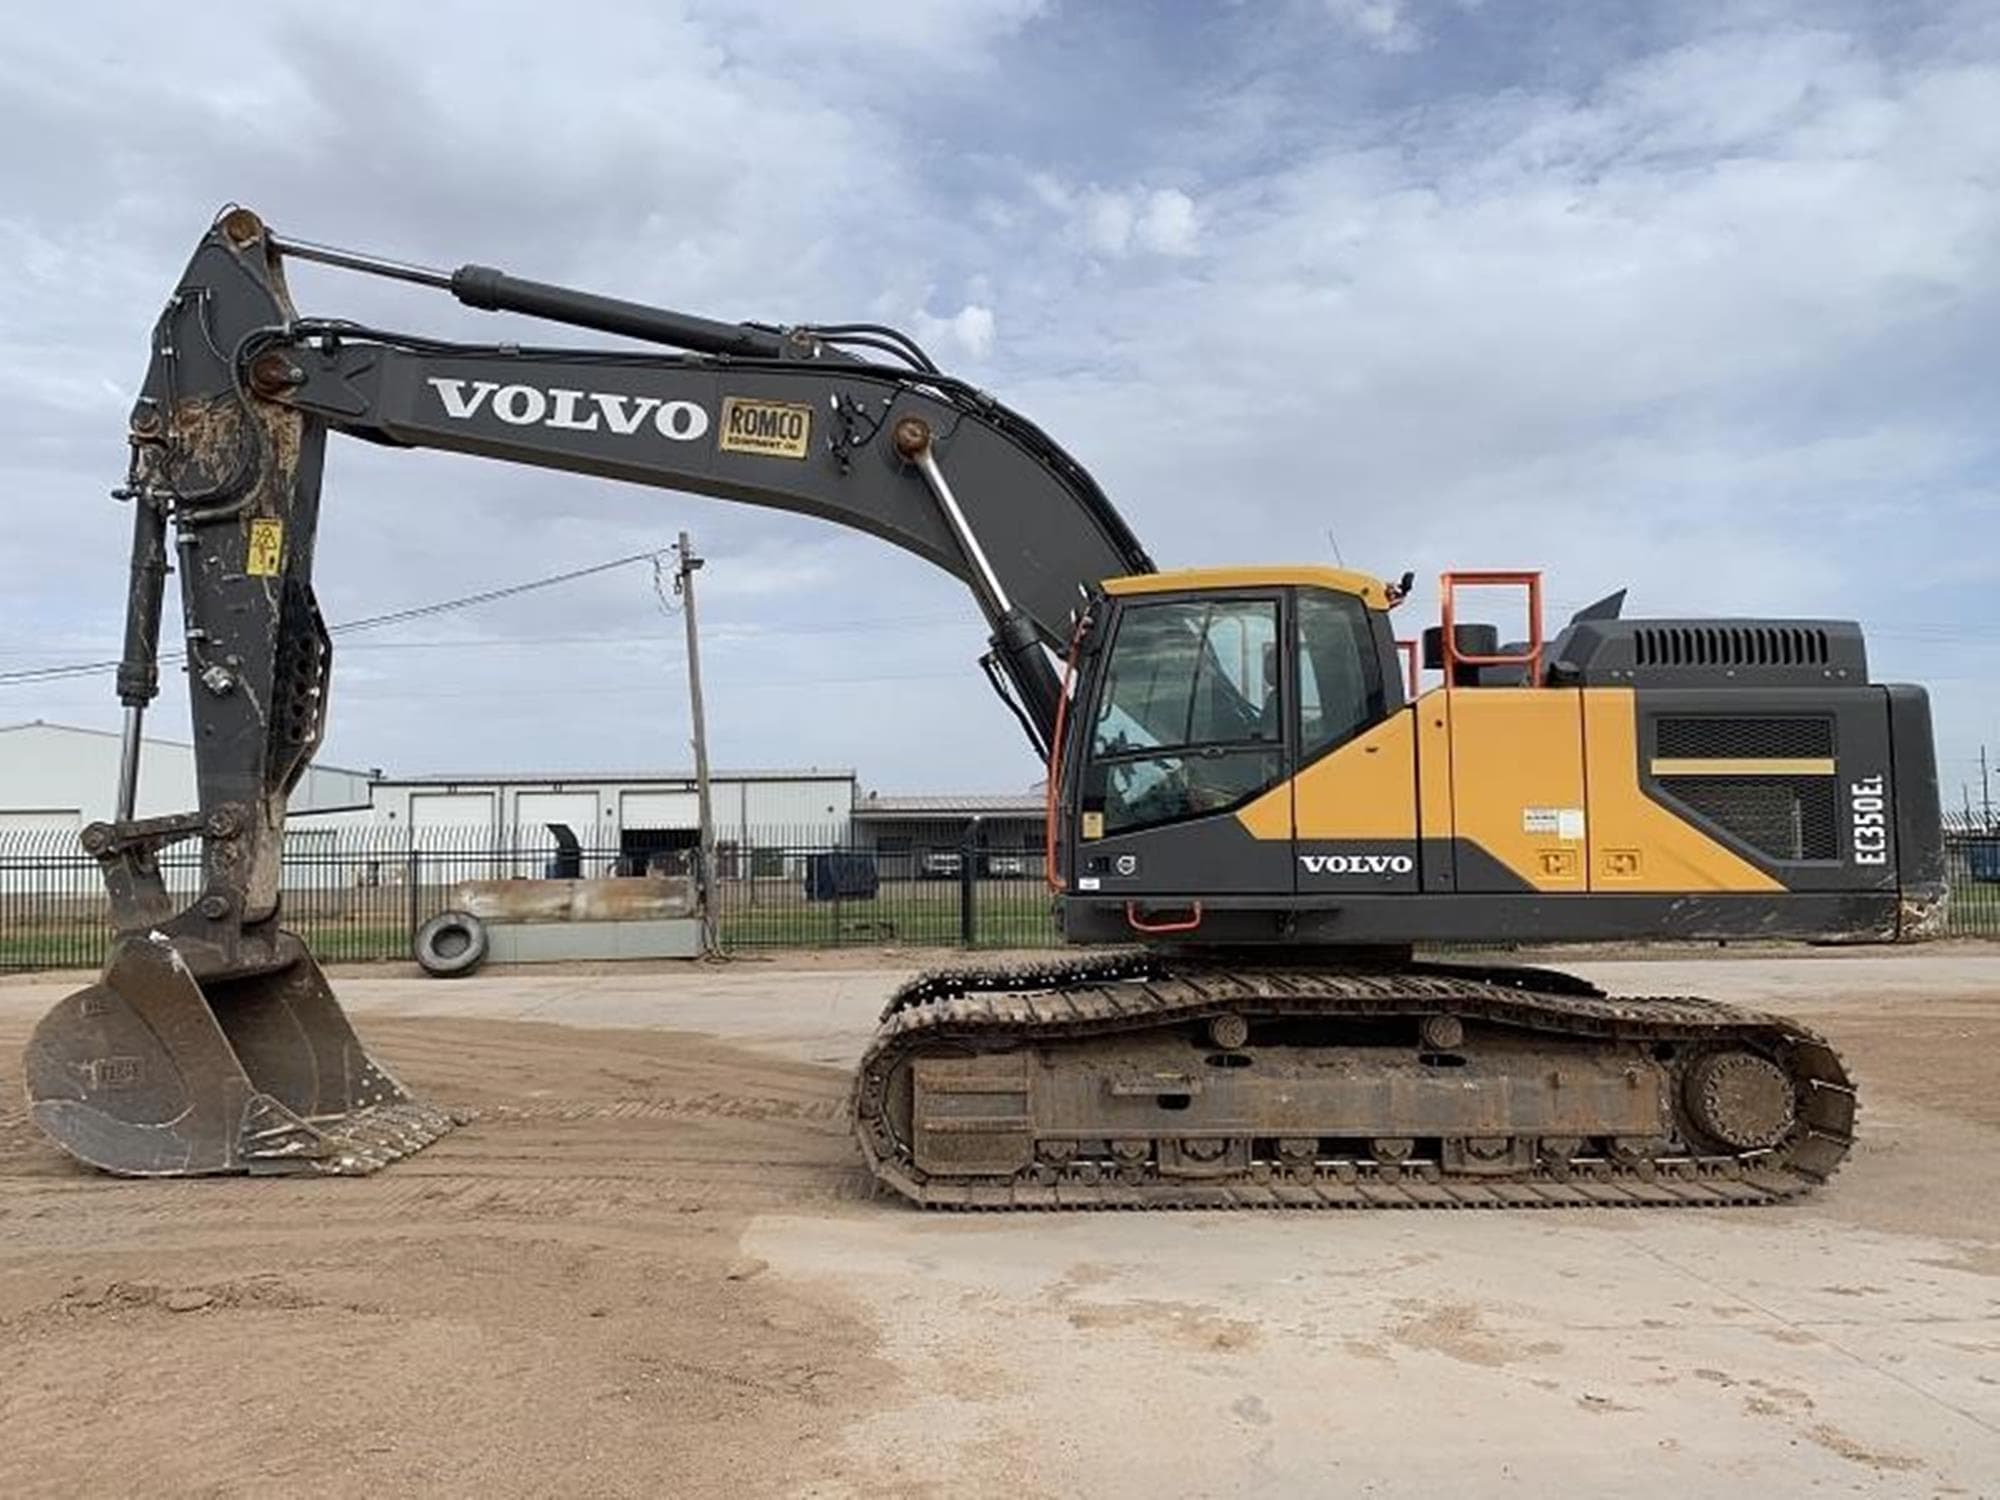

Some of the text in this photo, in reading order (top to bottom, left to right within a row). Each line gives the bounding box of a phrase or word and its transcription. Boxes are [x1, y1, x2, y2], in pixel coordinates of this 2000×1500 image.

[428, 378, 708, 440] VOLVO
[730, 406, 803, 440] ROMCO
[1299, 855, 1413, 873] VOLVO
